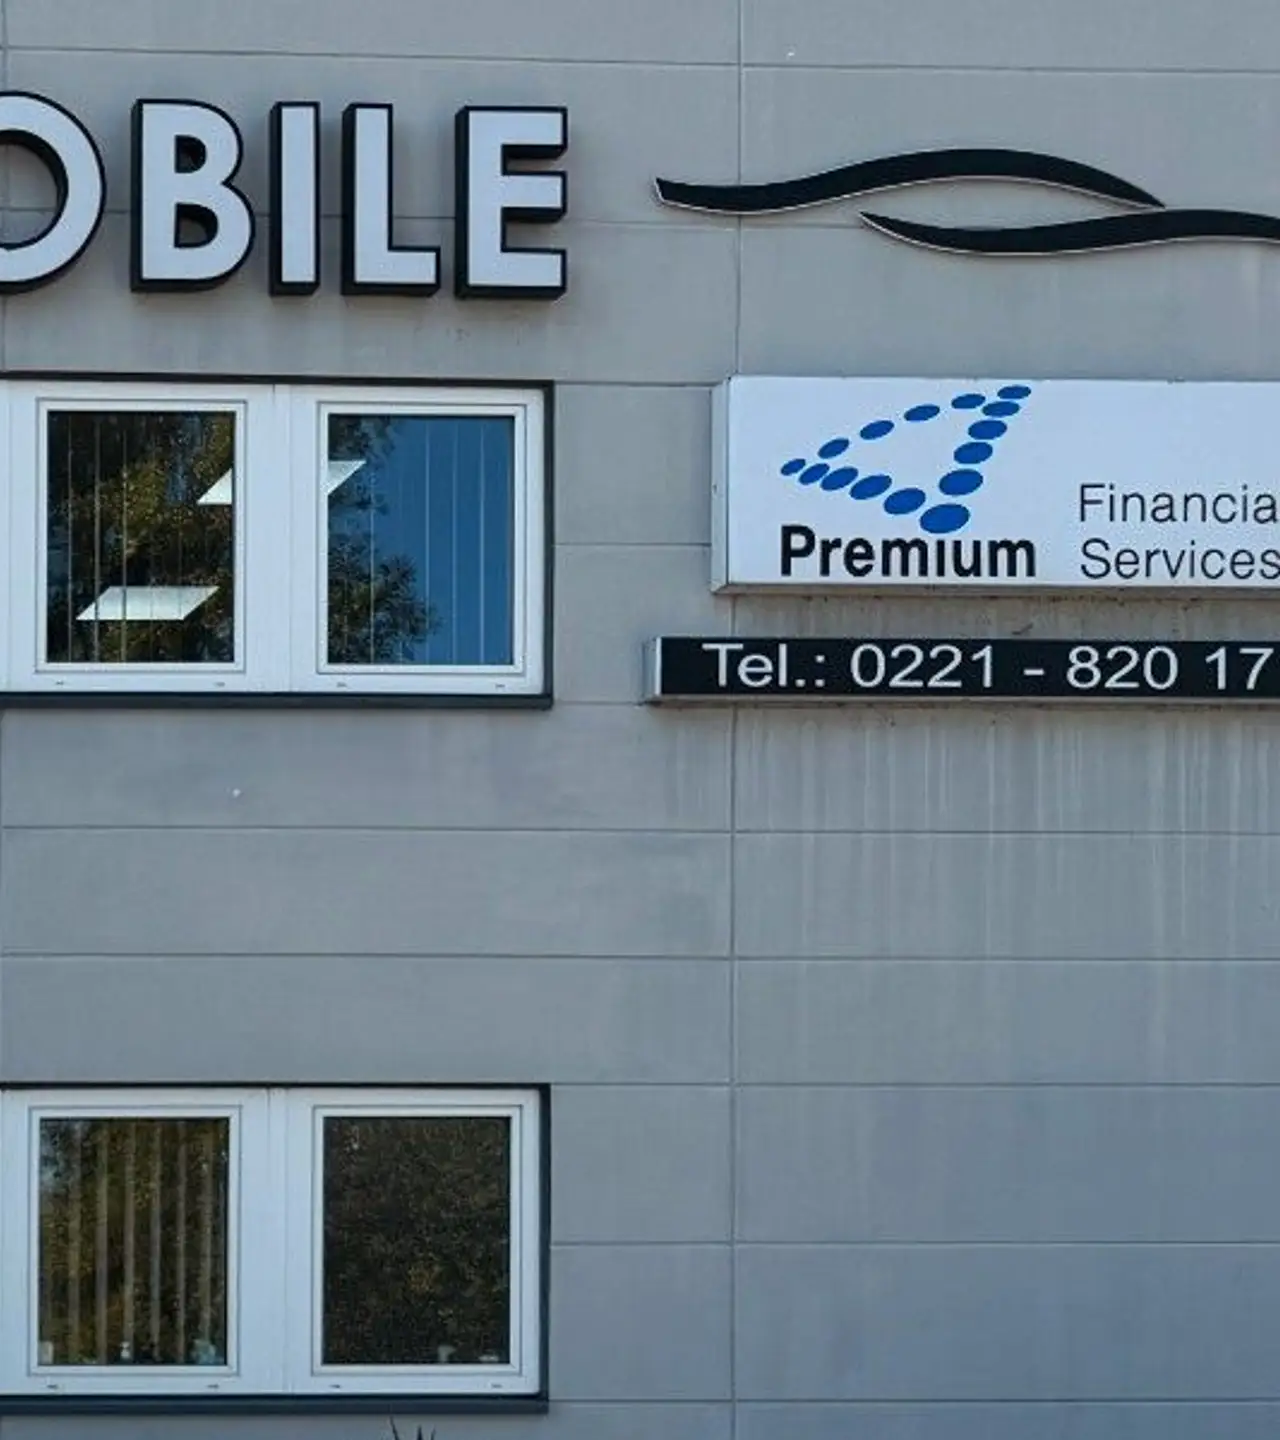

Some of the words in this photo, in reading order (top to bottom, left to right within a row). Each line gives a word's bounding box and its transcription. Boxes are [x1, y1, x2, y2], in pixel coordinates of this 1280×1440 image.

[780, 525, 1037, 578] Premium
[1079, 537, 1280, 581] Services
[702, 643, 825, 688] Tel.:
[850, 644, 994, 690] 0221
[1066, 645, 1179, 690] 820
[1204, 646, 1274, 690] 17
